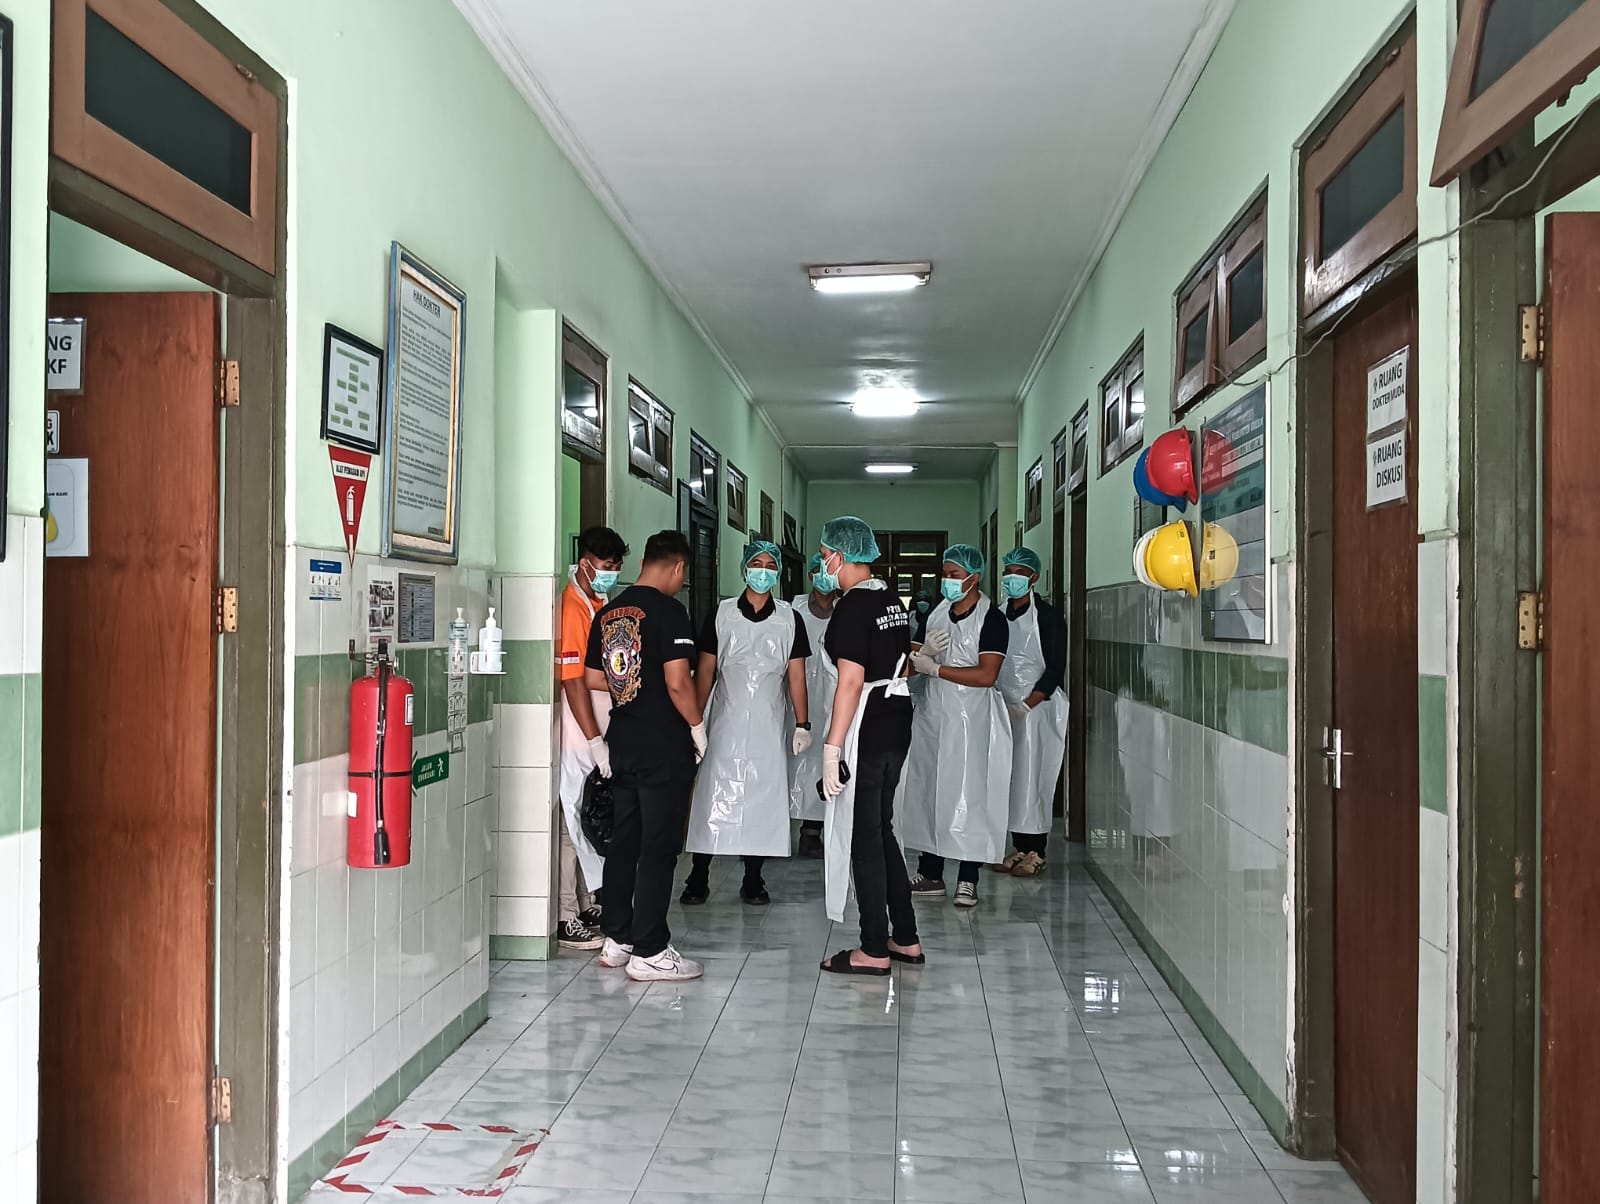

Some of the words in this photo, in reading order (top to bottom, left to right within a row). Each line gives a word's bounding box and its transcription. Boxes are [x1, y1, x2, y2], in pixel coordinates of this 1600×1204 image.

[1379, 362, 1402, 389] RUANG
[1372, 393, 1390, 410] DOKTER
[1390, 383, 1405, 404] MUDA
[1377, 440, 1402, 464] RUANG
[1376, 464, 1403, 489] DISKUSI
